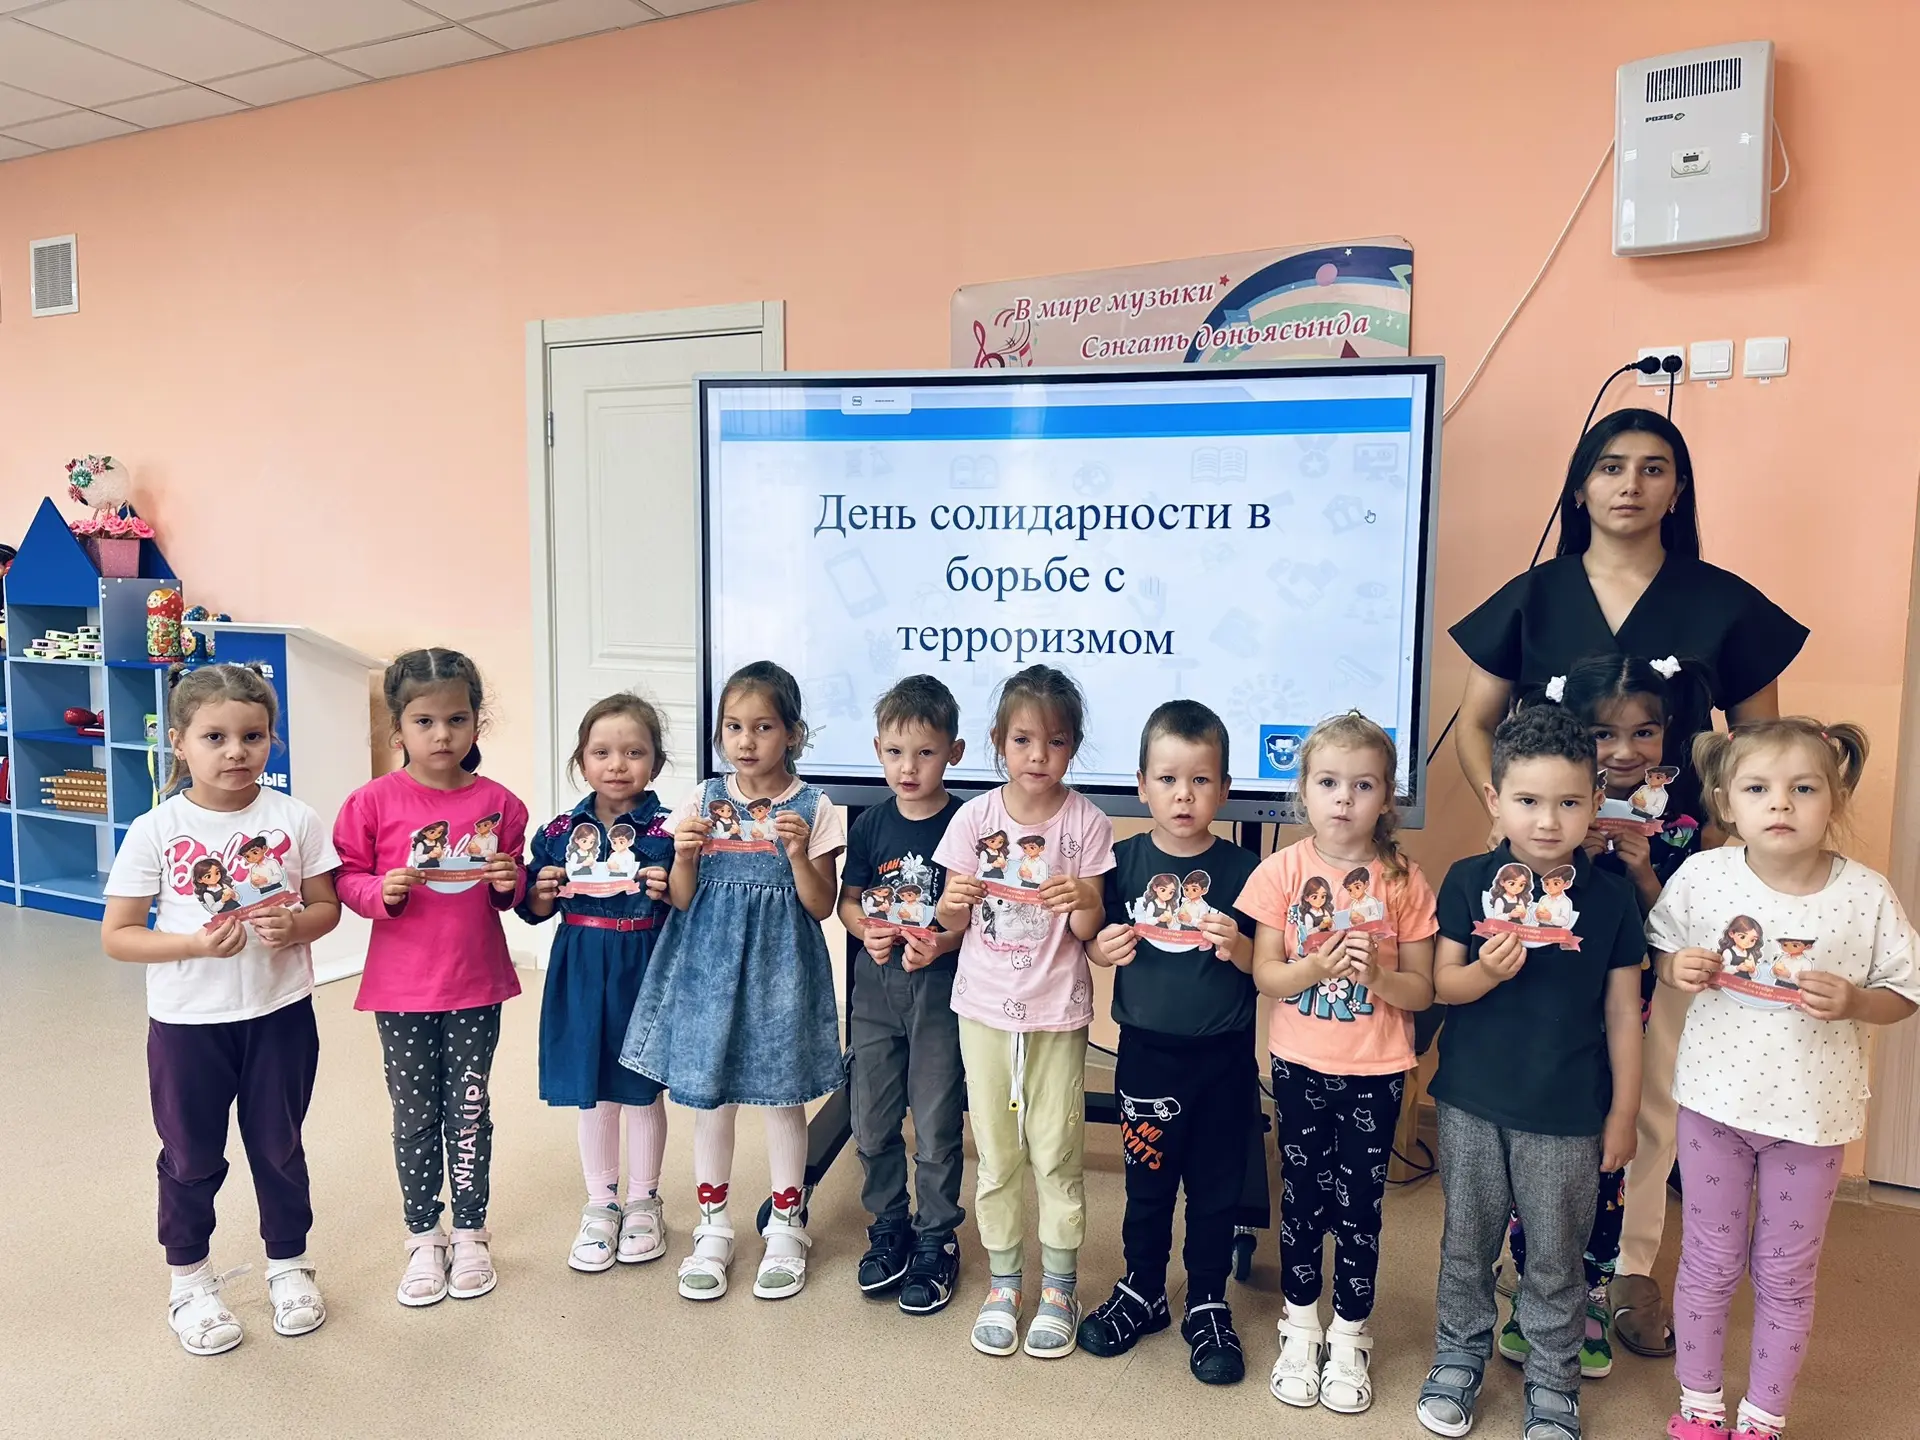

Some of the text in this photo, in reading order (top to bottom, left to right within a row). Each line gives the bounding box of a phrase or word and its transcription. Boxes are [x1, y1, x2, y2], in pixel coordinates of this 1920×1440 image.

[1645, 113, 1673, 122] POZIS
[1014, 284, 1214, 322] В мире музыки
[1081, 312, 1369, 358] Сәнгать дөньясында
[813, 494, 1271, 541] День солидарности в
[946, 554, 1125, 602] борьбе с
[897, 626, 1175, 663] терроризмом
[1283, 975, 1375, 1022] IRL
[1120, 1112, 1164, 1170] IMITS
[1136, 1121, 1164, 1143] NO
